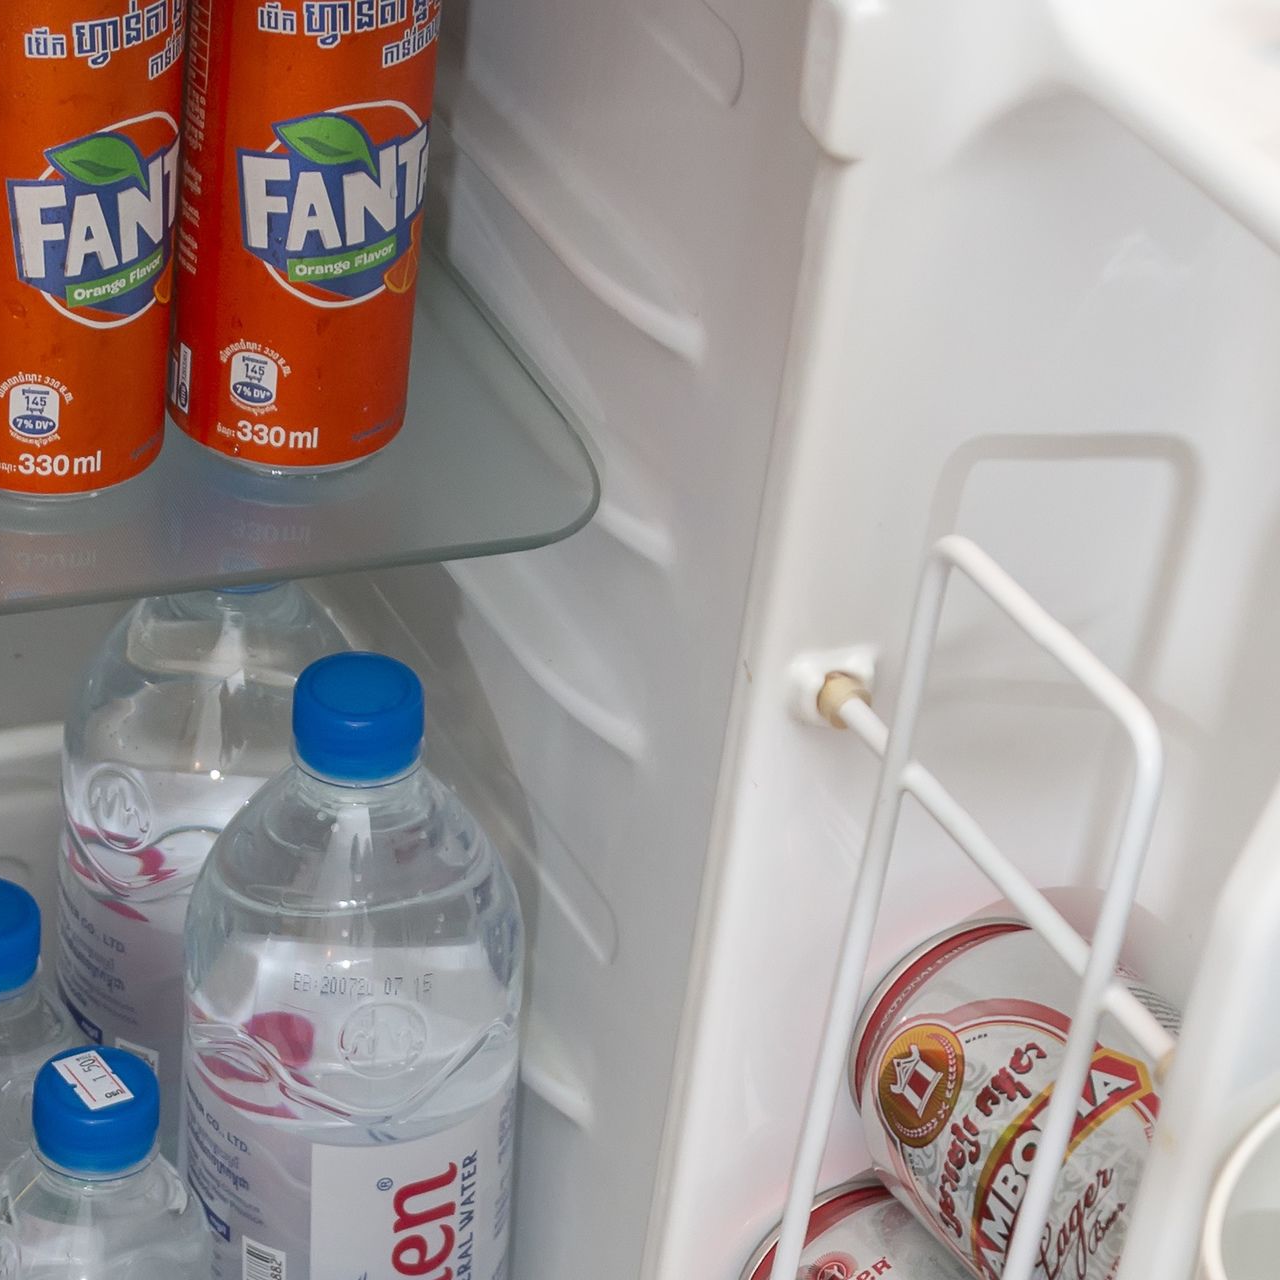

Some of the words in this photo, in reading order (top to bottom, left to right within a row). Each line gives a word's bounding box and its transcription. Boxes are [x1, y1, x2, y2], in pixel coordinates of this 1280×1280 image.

[13, 135, 180, 279] FANT
[295, 260, 350, 275] Orange
[355, 242, 394, 267] Flavor
[73, 278, 126, 300] Orange
[129, 254, 162, 284] Flavor
[245, 363, 265, 377] 145
[24, 395, 47, 407] 145
[237, 420, 285, 447] 330
[289, 427, 319, 449] ml
[18, 453, 70, 476] 330
[73, 450, 101, 475] ml
[458, 1149, 477, 1232] WATER
